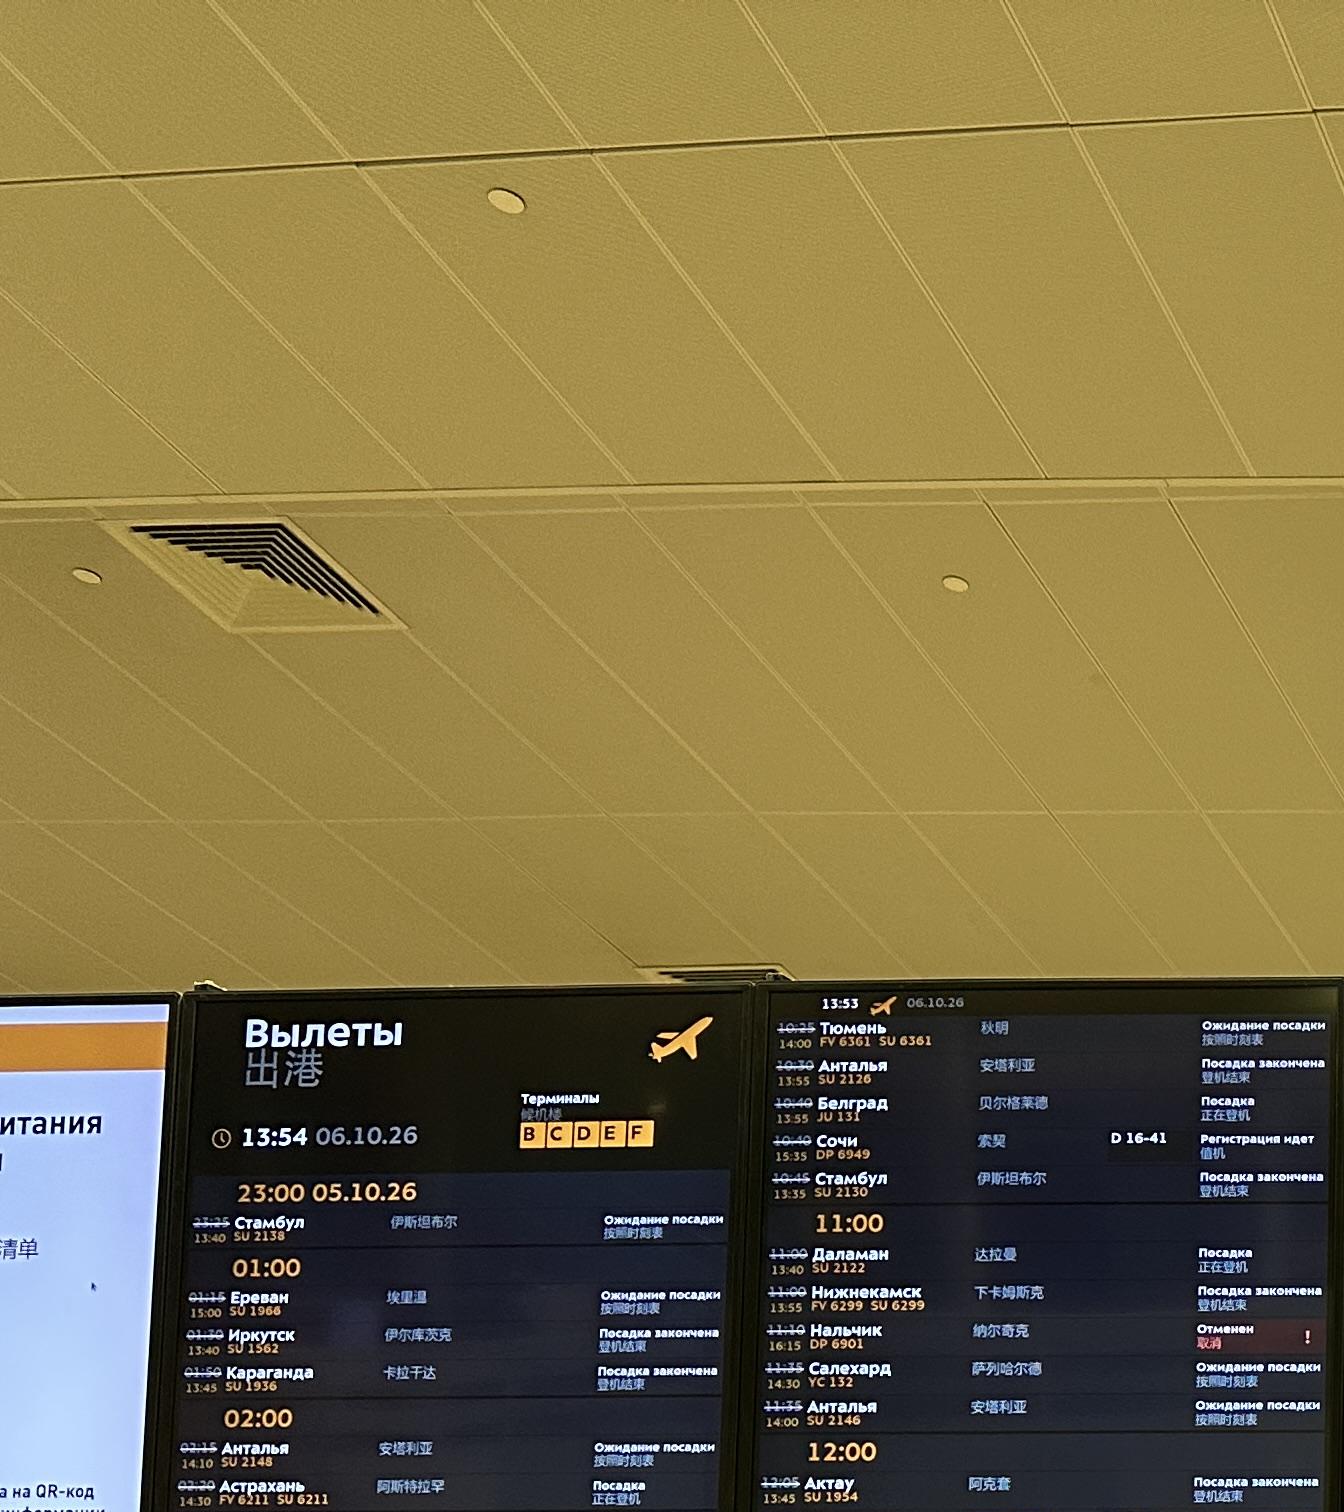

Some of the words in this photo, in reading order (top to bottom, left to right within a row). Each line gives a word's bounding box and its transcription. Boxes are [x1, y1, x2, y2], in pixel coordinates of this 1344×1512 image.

[823, 999, 858, 1009] 13:53
[907, 998, 964, 1008] 06.10.26
[246, 1019, 402, 1047] Вылеты
[246, 1048, 323, 1088] 出港
[521, 1094, 599, 1106] Терминалы
[818, 1097, 888, 1112] Белград
[243, 1128, 307, 1146] 13:54
[316, 1126, 417, 1145] 06.10.26
[524, 1127, 534, 1141] B
[550, 1126, 562, 1141] C
[578, 1126, 590, 1140] D
[605, 1126, 616, 1140] E
[632, 1125, 642, 1139] F
[240, 1184, 305, 1203] 23:00
[312, 1183, 416, 1201] 05.10.26
[235, 1216, 304, 1231] Стамбул
[817, 1214, 883, 1232] 11:00
[234, 1231, 253, 1242] SU
[255, 1230, 285, 1241] 2138
[233, 1259, 301, 1277] 01:00
[812, 1286, 921, 1299] Нижнекамск
[1197, 1324, 1254, 1334] Отменен
[227, 1367, 313, 1381] Караганда
[809, 1442, 877, 1461] 12:00
[13, 1488, 30, 1498] на
[37, 1484, 94, 1500] QR-код
